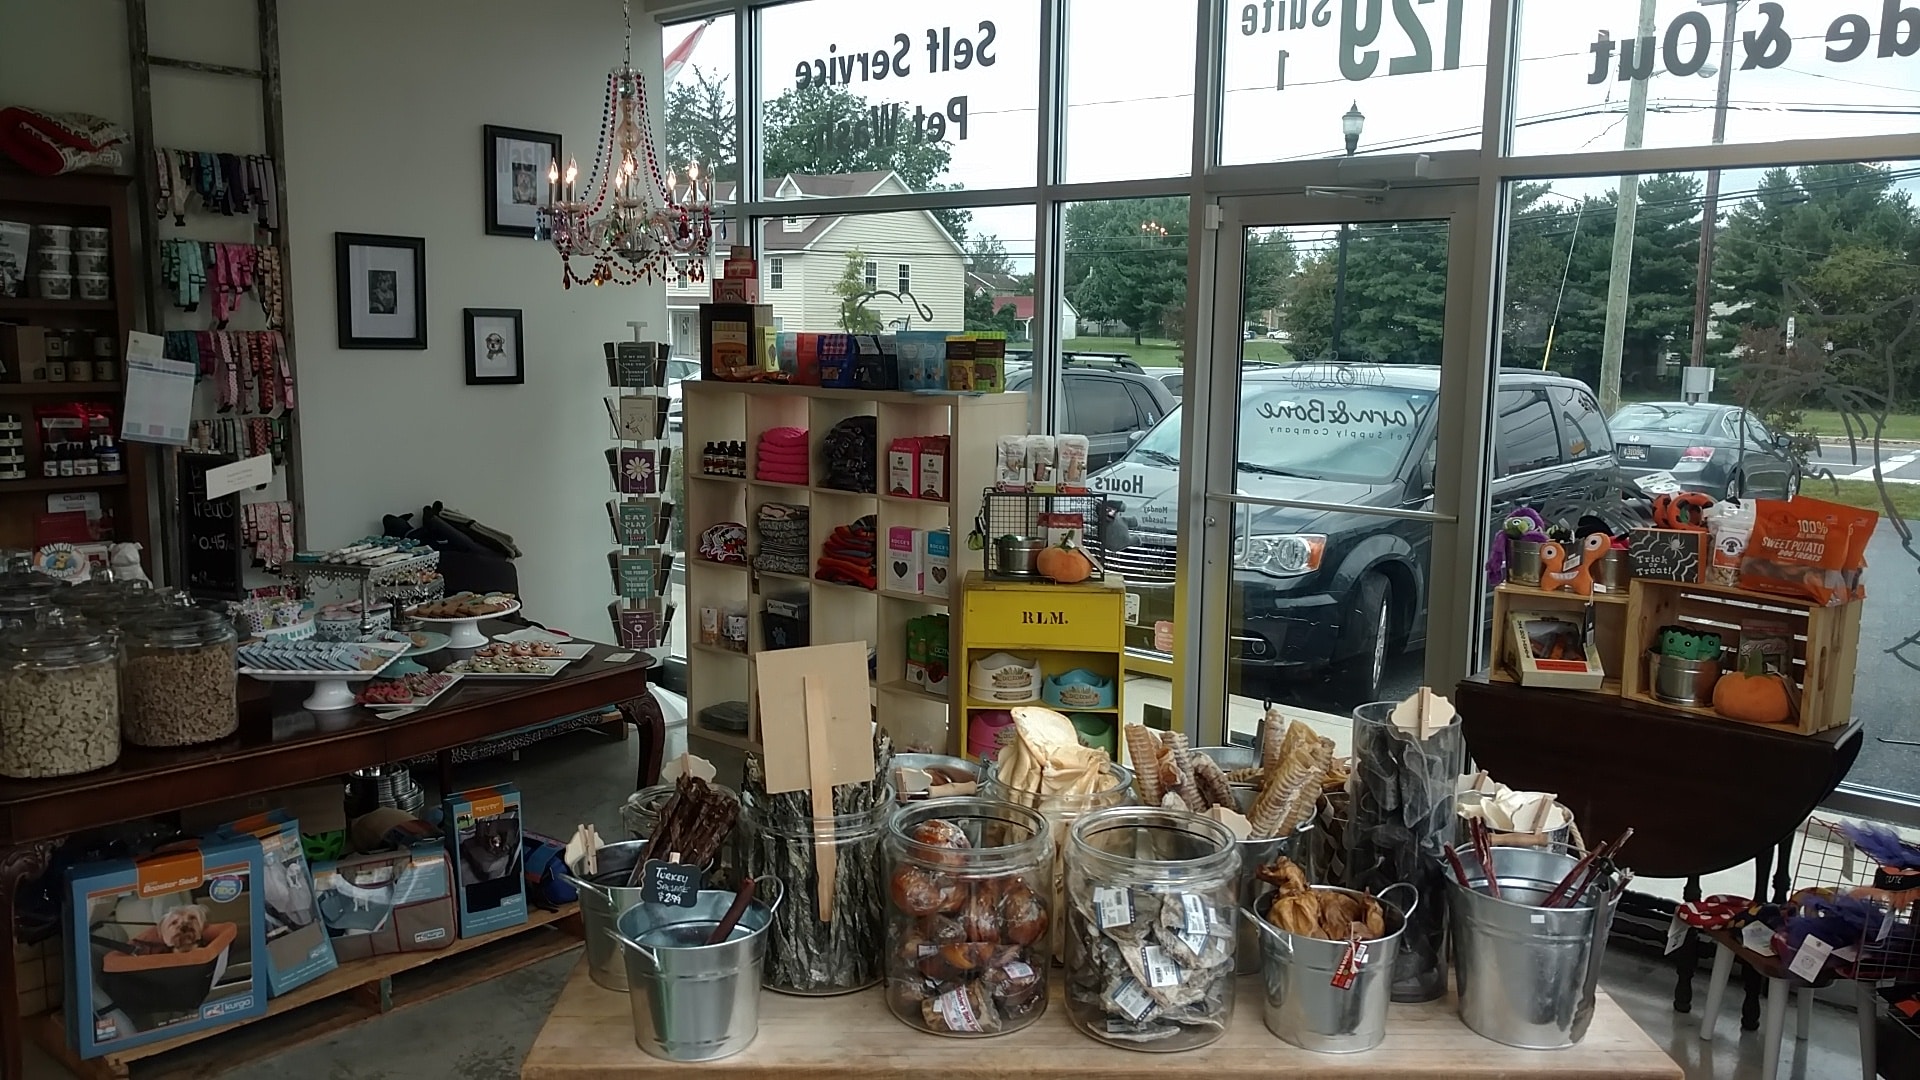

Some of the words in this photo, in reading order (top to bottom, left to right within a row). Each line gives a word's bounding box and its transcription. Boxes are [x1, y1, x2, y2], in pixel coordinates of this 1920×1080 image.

[1797, 519, 1828, 535] 100%
[1761, 536, 1791, 550] SWEET
[1791, 540, 1825, 555] POTATO
[1636, 554, 1668, 566] Trick
[1778, 549, 1793, 558] DOG
[1794, 551, 1822, 562] TREATS
[1636, 565, 1672, 577] Treat!
[178, 876, 199, 887] Seat
[658, 891, 681, 904] $2.99
[224, 998, 252, 1012] kurgo
